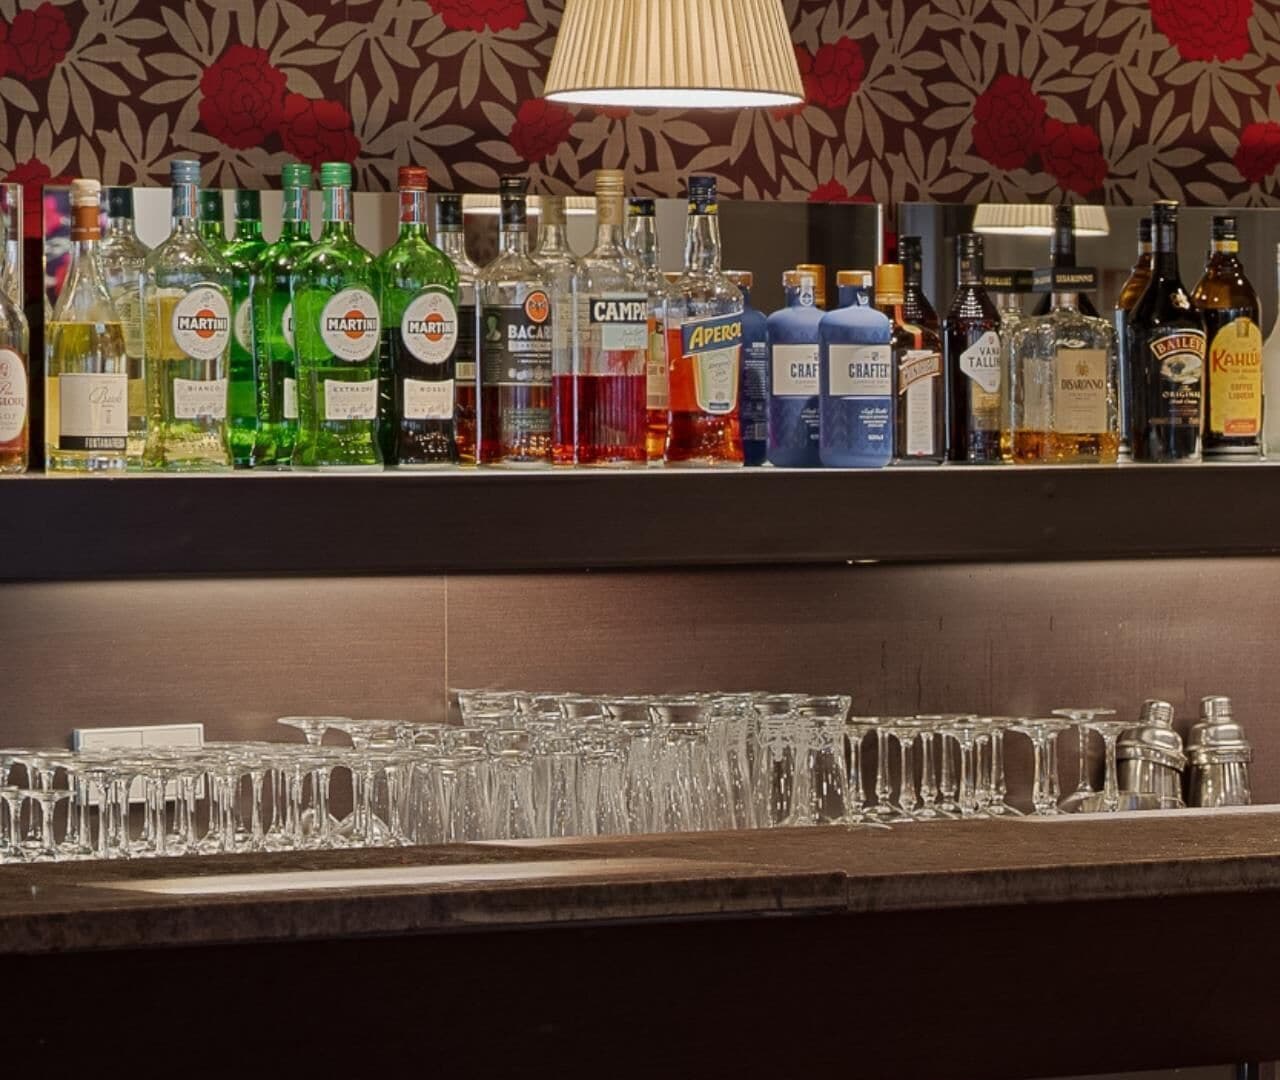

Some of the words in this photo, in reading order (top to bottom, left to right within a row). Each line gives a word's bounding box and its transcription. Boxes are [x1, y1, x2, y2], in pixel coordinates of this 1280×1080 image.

[179, 316, 228, 331] MARTINI
[327, 317, 376, 331] MARTINI
[409, 321, 455, 334] MARTINI
